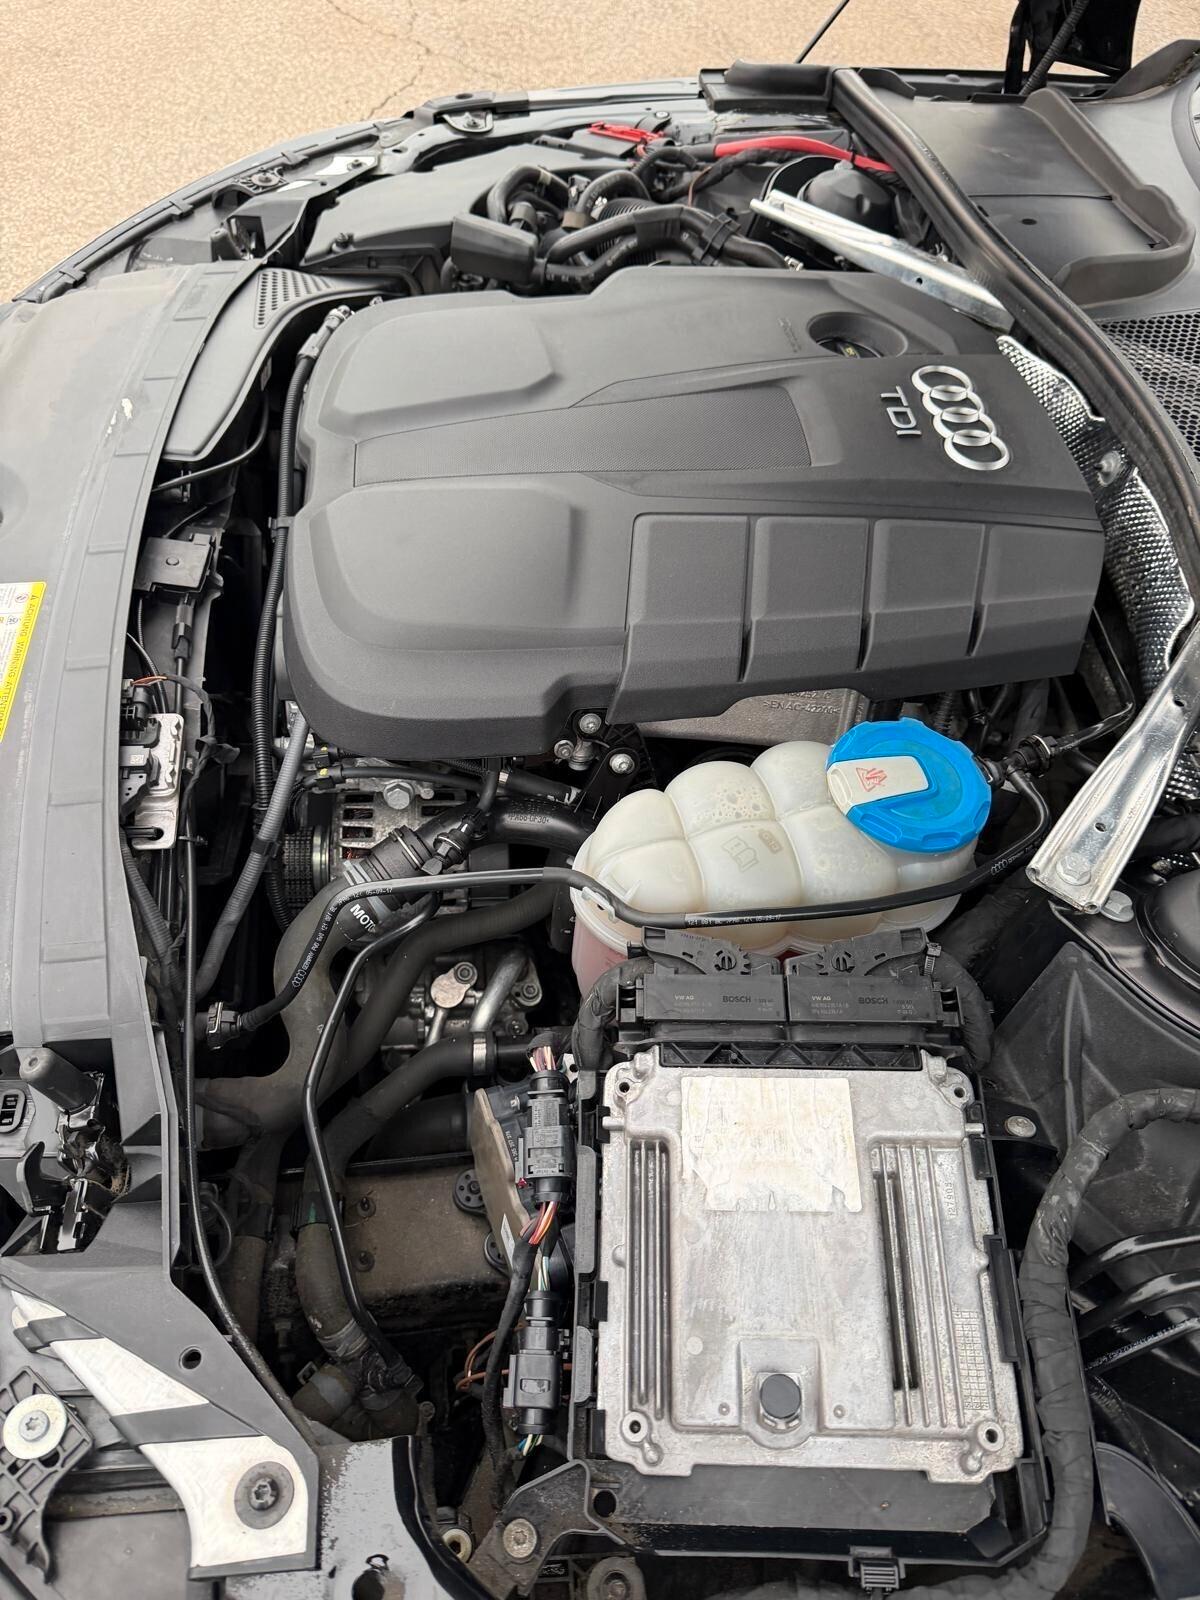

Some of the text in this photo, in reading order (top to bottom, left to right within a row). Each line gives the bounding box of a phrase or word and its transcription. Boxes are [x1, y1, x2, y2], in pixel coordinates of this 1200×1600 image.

[881, 385, 922, 436] TDI
[20, 603, 35, 637] ACHTUNG
[8, 641, 24, 678] WARNING
[722, 995, 751, 1003] BOSCH
